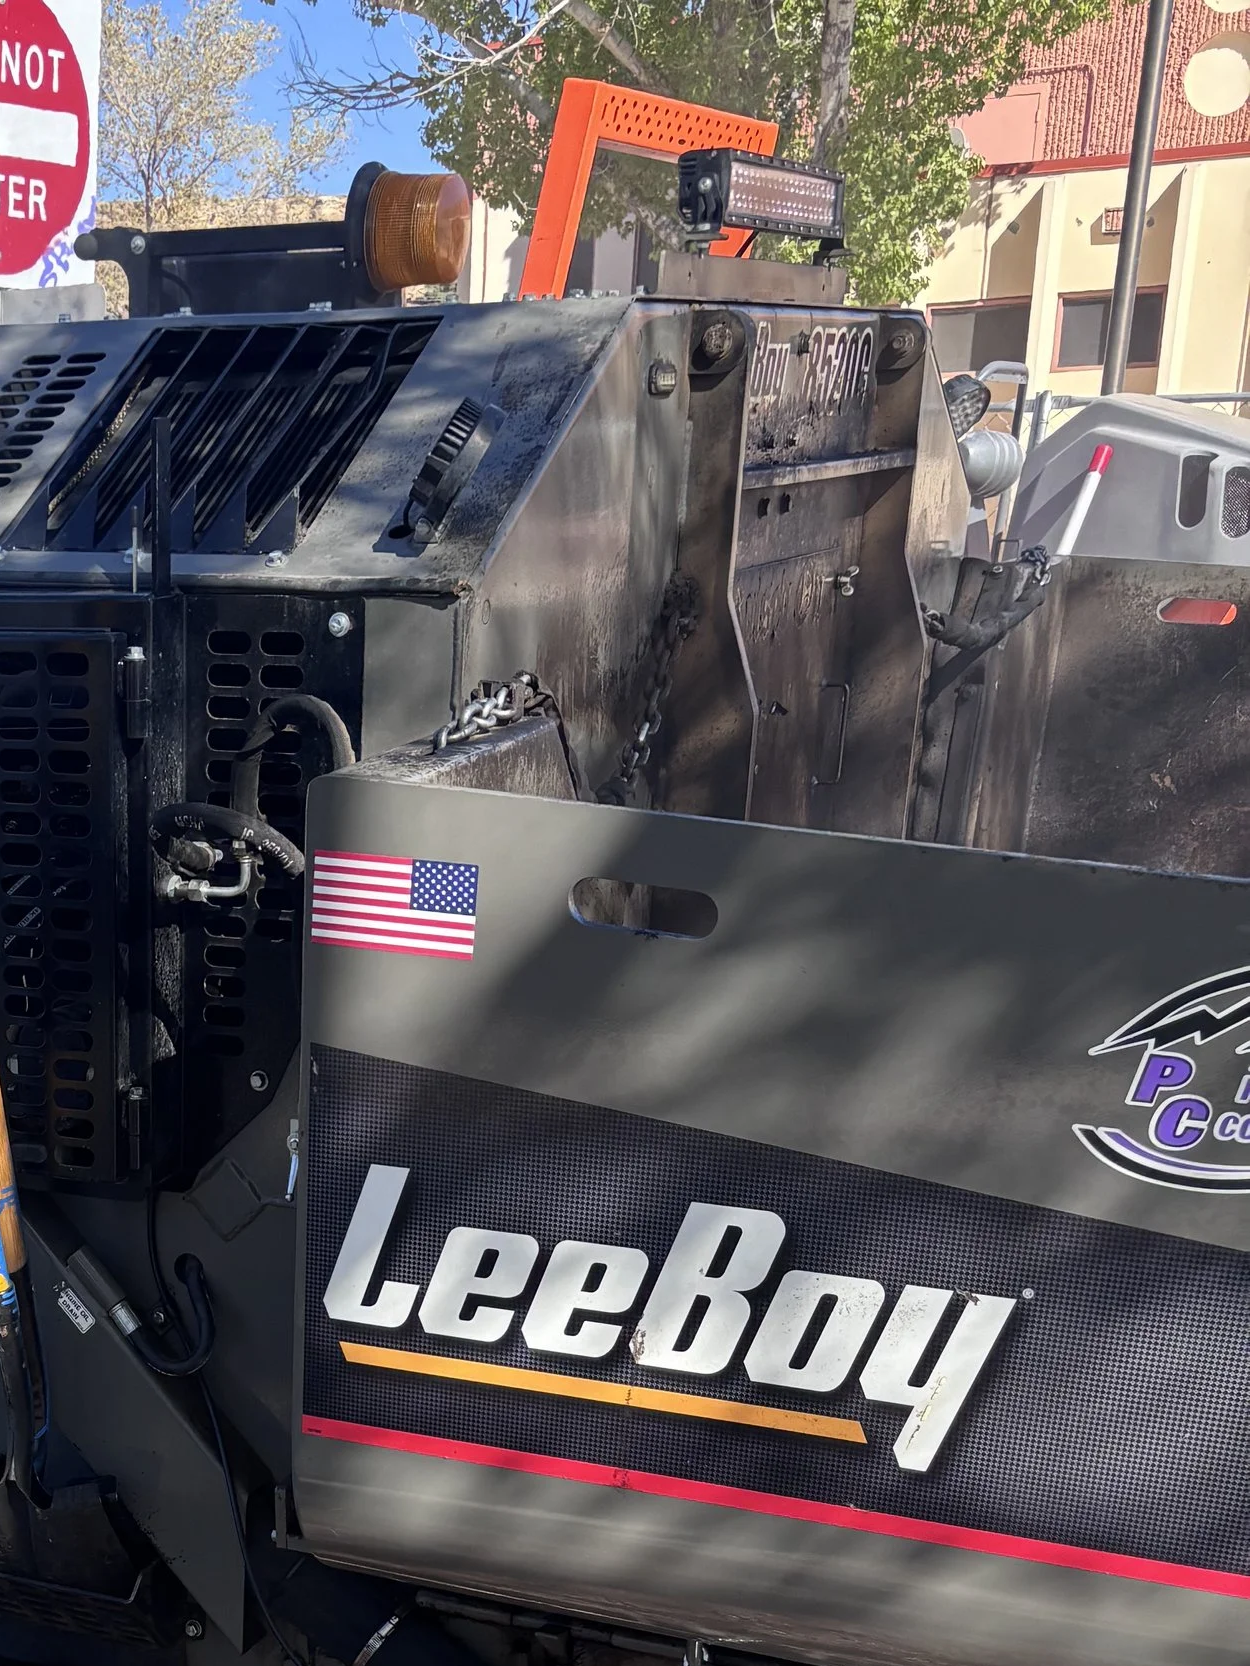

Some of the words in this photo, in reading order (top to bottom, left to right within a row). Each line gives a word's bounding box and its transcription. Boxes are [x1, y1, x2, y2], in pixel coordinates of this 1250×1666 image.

[1, 40, 65, 93] NOT
[1125, 1050, 1196, 1107] P
[1148, 1094, 1213, 1152] C
[322, 1163, 1017, 1473] LeeBoy
